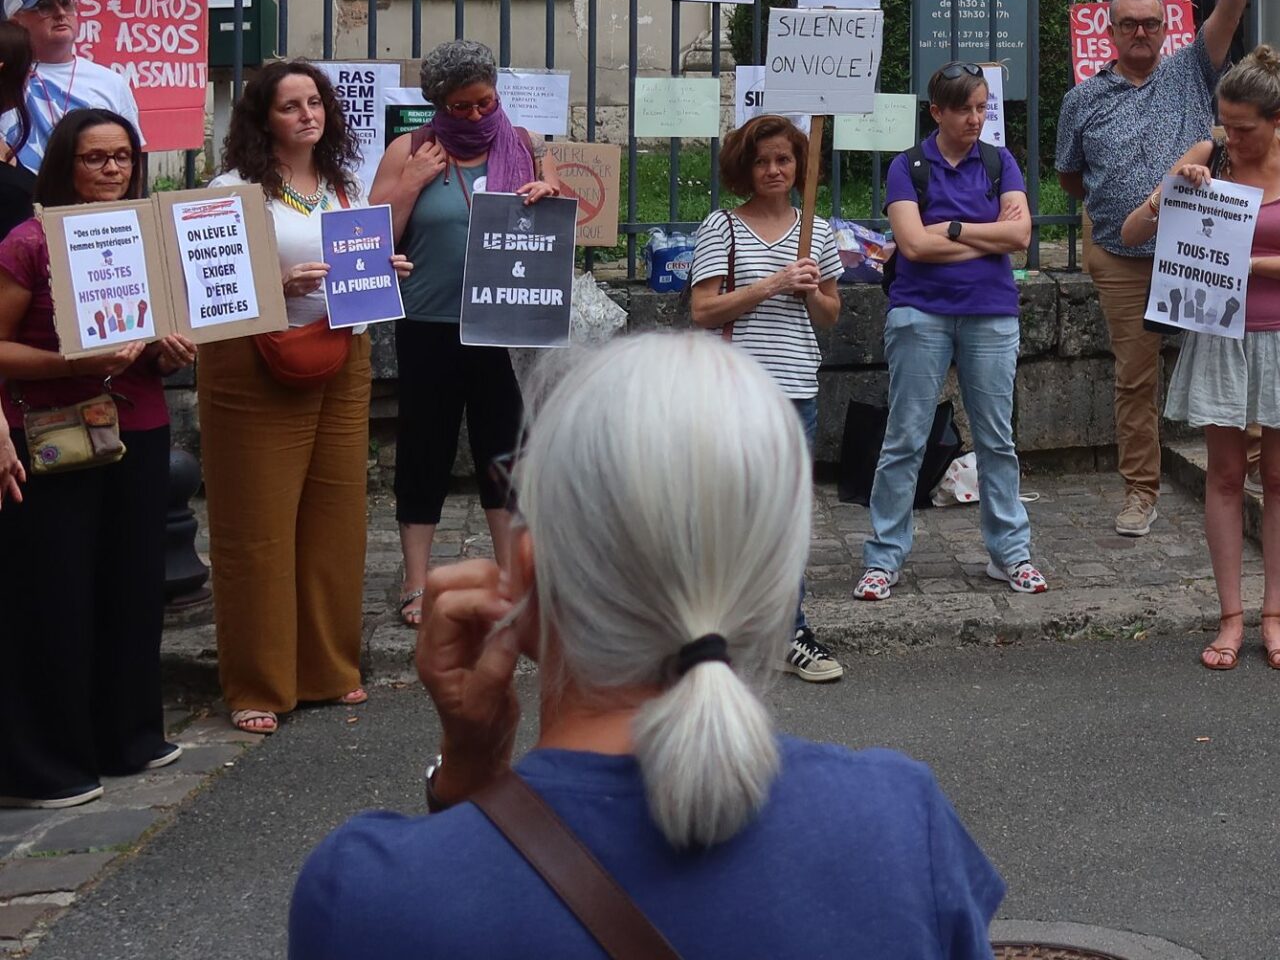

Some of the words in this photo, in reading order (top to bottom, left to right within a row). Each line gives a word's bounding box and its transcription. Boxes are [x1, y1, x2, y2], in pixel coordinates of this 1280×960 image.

[115, 22, 199, 54] ASSOS
[1077, 38, 1112, 59] LES
[772, 56, 796, 73] ON
[338, 71, 375, 84] RAS
[336, 85, 374, 98] SEM
[1195, 187, 1208, 199] cris
[1208, 191, 1219, 202] de
[1220, 193, 1249, 208] bonnes
[1197, 202, 1242, 222] hystériques
[90, 228, 100, 236] cris
[110, 224, 132, 233] bonnes
[188, 230, 201, 242] ON
[203, 226, 226, 240] LÈVE
[227, 225, 238, 237] LE
[95, 237, 132, 249] hystériques
[333, 240, 346, 253] LE
[348, 236, 380, 252] BRUIT
[483, 232, 501, 249] LE
[505, 233, 556, 252] BRUIT
[188, 247, 218, 261] POING
[219, 243, 243, 257] POUR
[203, 263, 236, 279] EXIGER
[356, 258, 365, 270] &
[512, 261, 525, 278] &
[1158, 259, 1234, 290] HISTORIQUES
[1236, 279, 1242, 291] !
[79, 284, 140, 303] HISTORIQUES
[206, 282, 239, 298] D'ÊTRE
[332, 281, 347, 295] LA
[348, 275, 392, 292] FUREUR
[471, 287, 492, 304] LA
[496, 287, 563, 306] FUREUR
